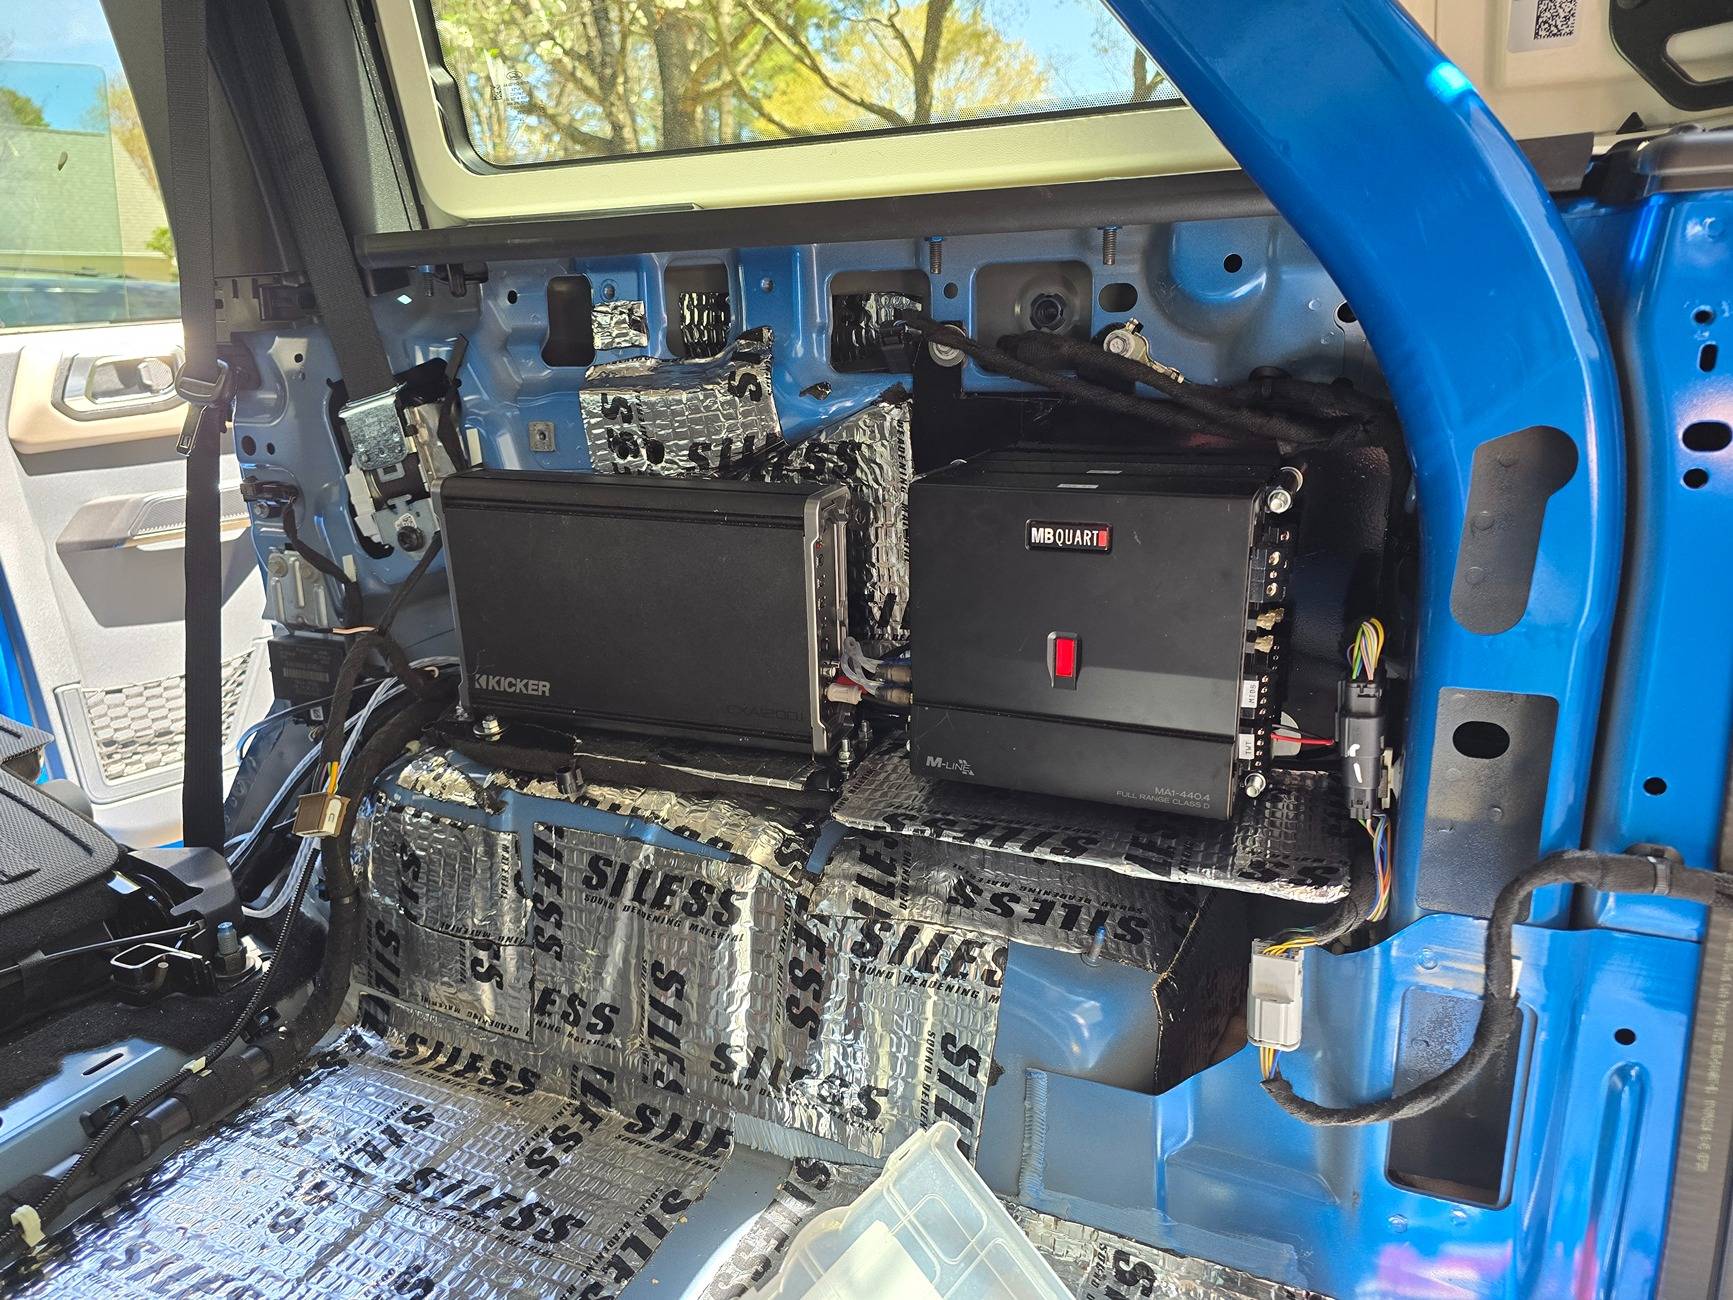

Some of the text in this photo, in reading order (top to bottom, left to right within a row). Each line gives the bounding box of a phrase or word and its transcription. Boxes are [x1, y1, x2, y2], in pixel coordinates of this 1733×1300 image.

[487, 675, 551, 696] KICKER
[1116, 790, 1210, 810] FULL RANGE CLASS D
[1154, 786, 1211, 801] MA1-440.4
[582, 854, 748, 927] SILESS
[584, 893, 615, 911] SOUND
[689, 923, 746, 942] MATERIAL
[948, 876, 1148, 945] SILESS
[851, 963, 895, 980] SOUND
[902, 975, 980, 999] DEADENING
[389, 1031, 541, 1096] SILESS
[920, 1030, 936, 1131] SOUND DEADEN
[714, 1074, 752, 1092] SOUND
[505, 1125, 549, 1165] MATERIAL
[614, 1133, 652, 1150] SOUND
[634, 1187, 664, 1218] SOUND
[580, 1221, 632, 1279] DEADENING
